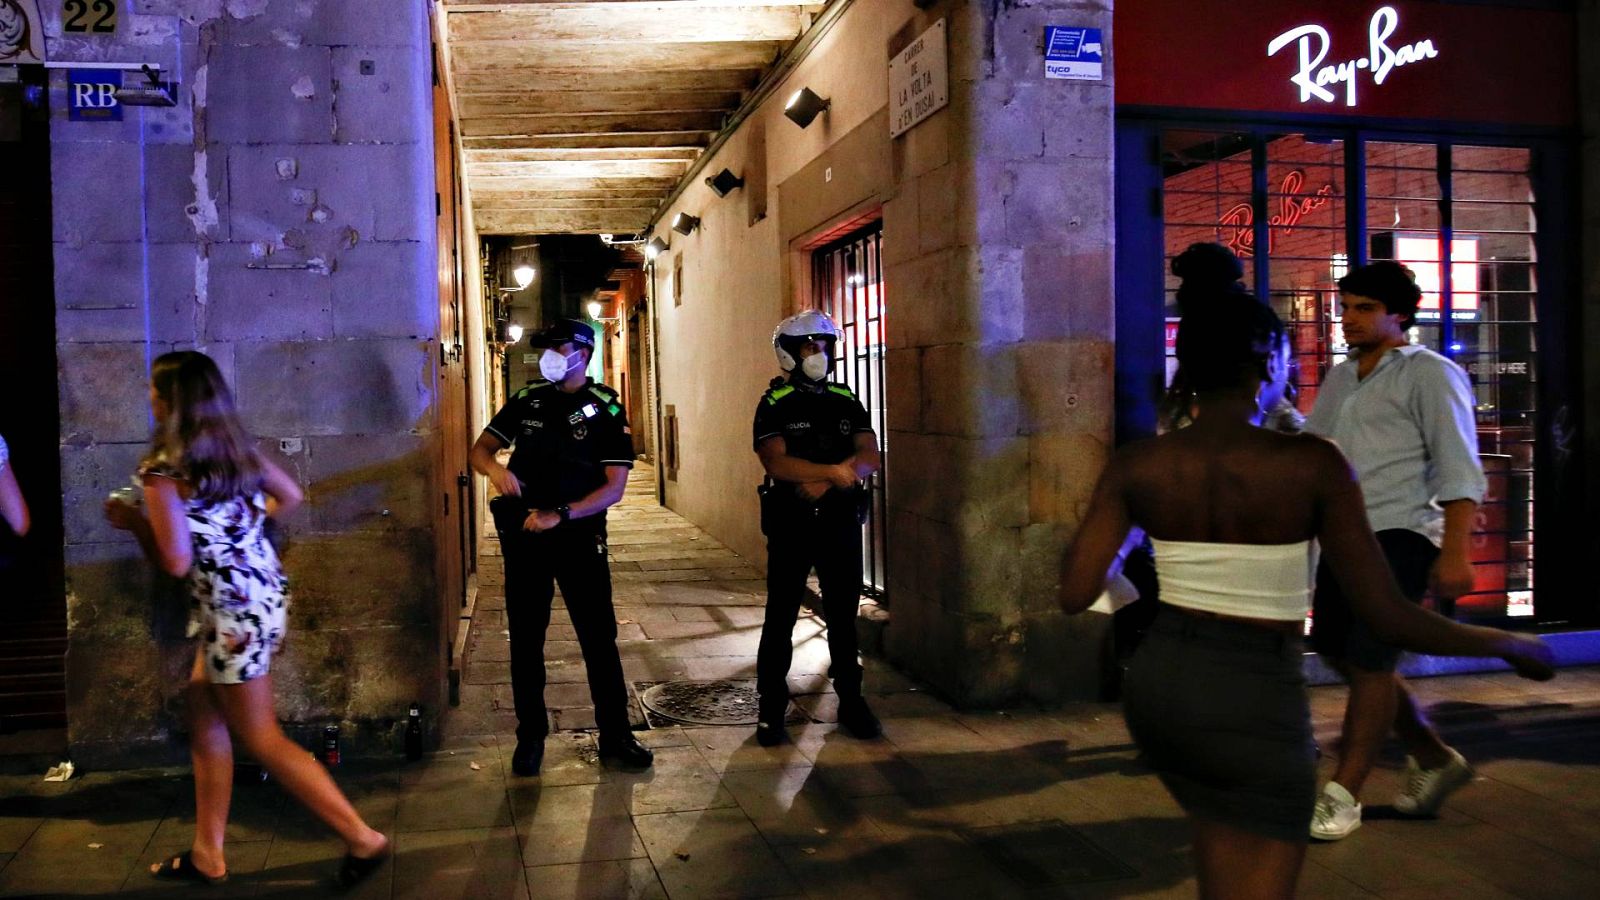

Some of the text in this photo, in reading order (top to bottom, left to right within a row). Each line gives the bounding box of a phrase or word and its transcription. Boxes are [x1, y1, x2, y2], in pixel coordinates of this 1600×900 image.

[63, 0, 115, 32] 22
[904, 38, 924, 65] CARRER
[911, 61, 918, 77] DE
[1047, 64, 1070, 74] tyco
[73, 83, 117, 108] RB
[899, 69, 932, 107] LA VOLTA
